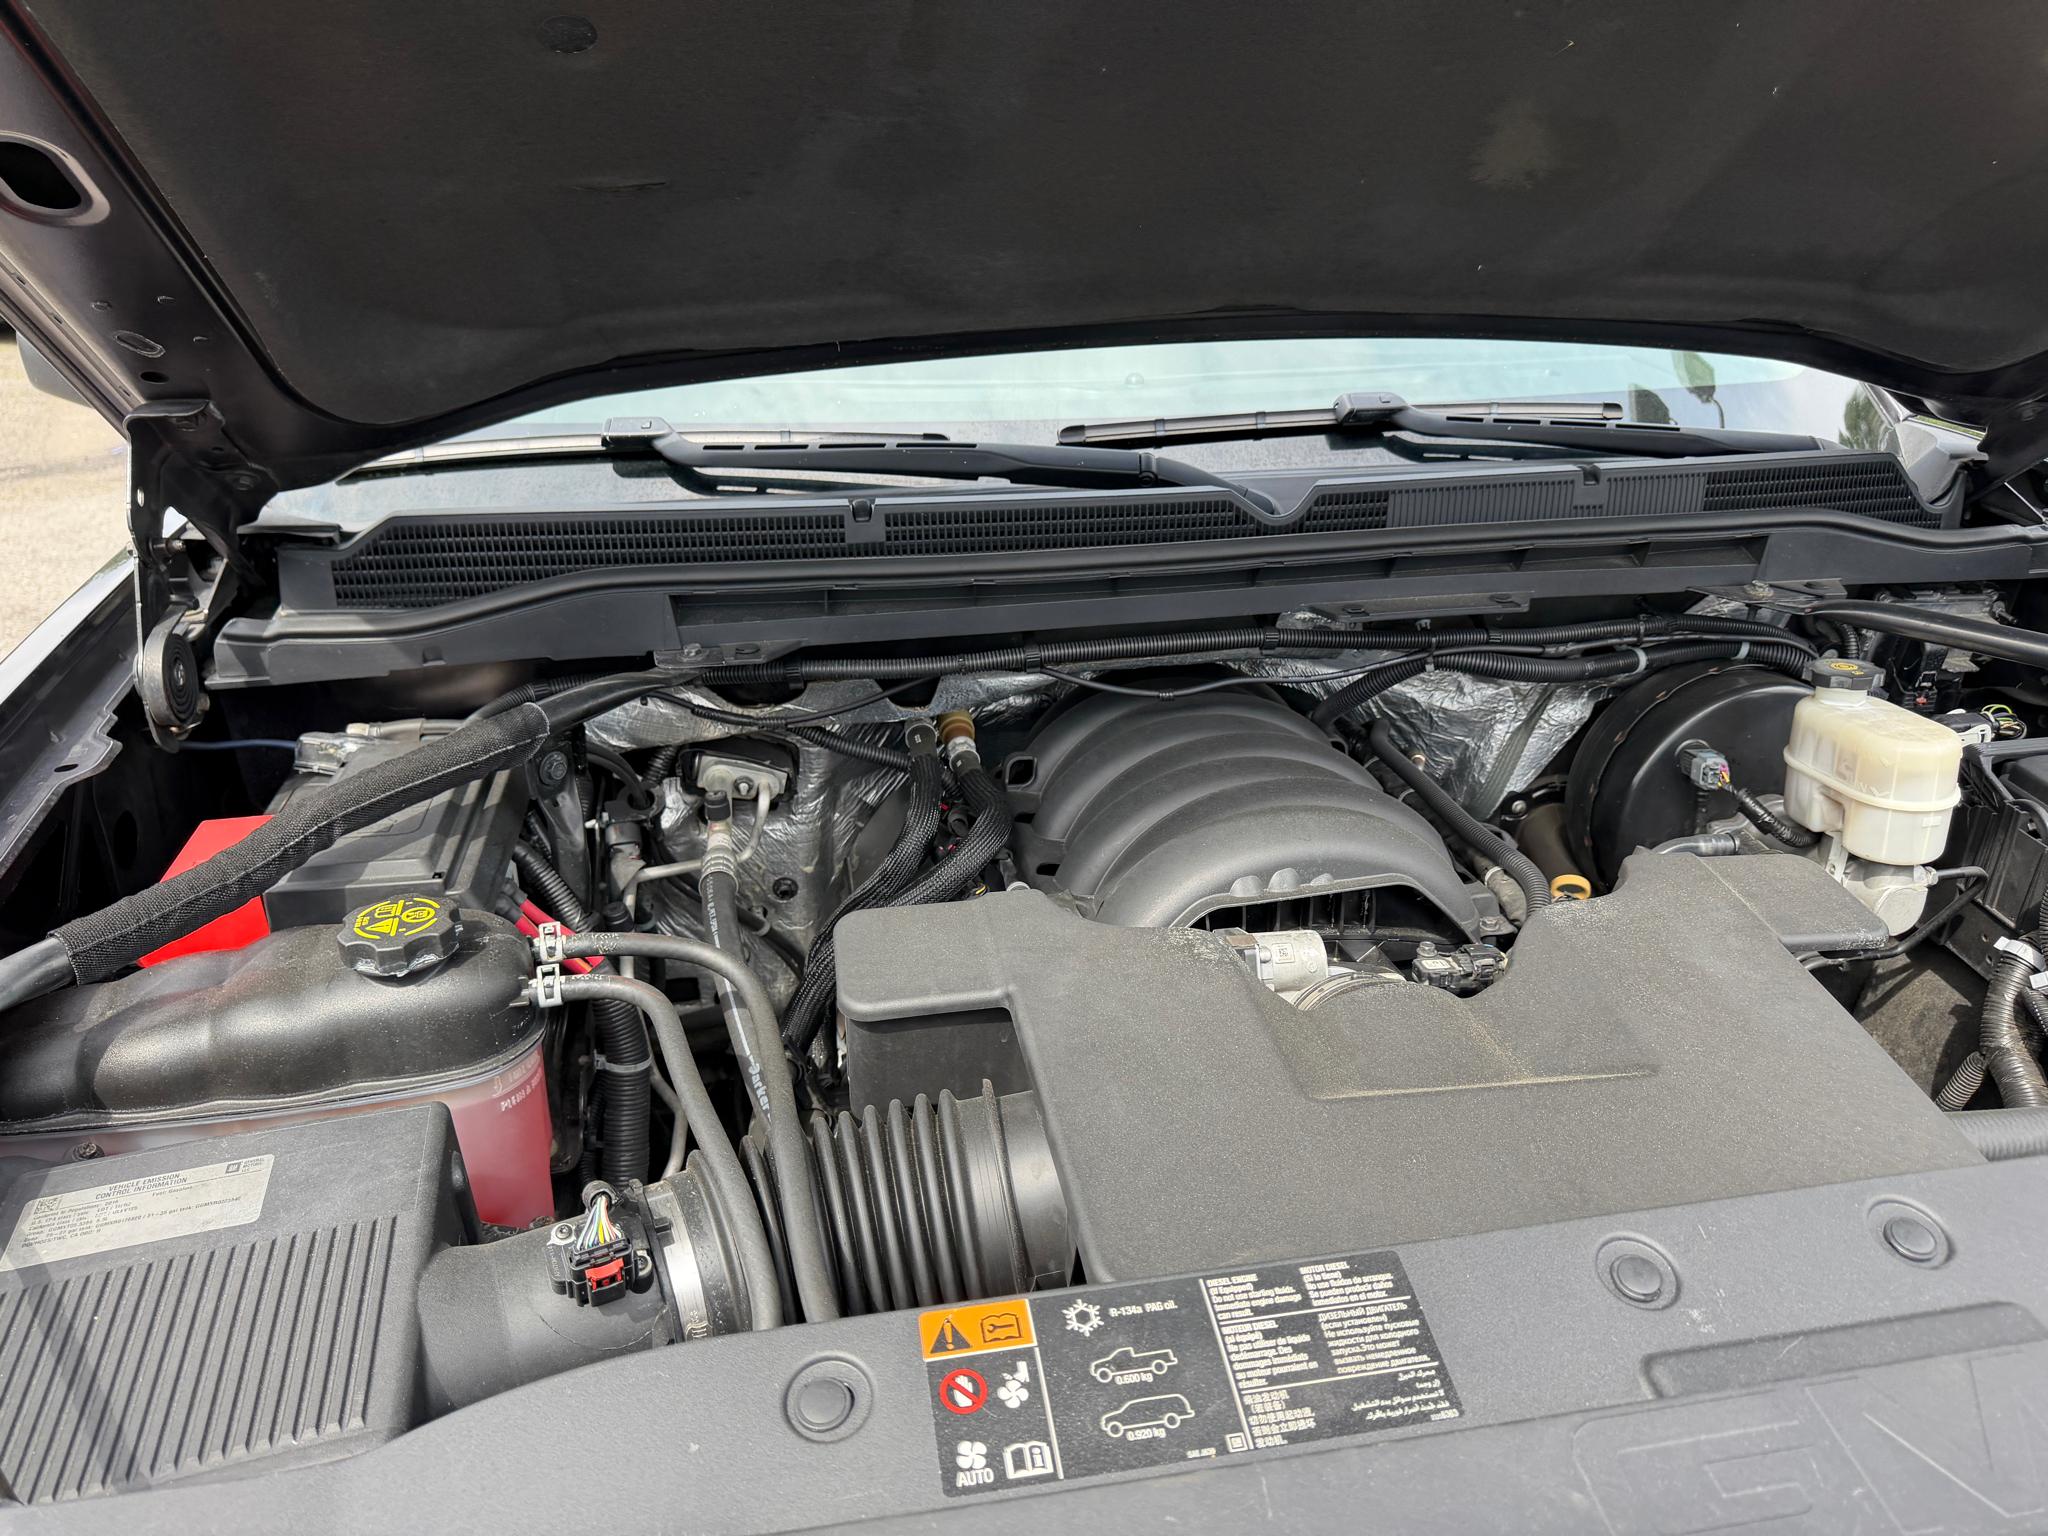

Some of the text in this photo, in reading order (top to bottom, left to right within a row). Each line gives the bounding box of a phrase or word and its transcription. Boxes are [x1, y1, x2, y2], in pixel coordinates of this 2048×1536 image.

[749, 1063, 769, 1110] Parker
[95, 1177, 187, 1200] CONTROL INFORMATION
[109, 1173, 180, 1191] VEHICLE EMISSION
[1299, 1261, 1350, 1275] MOTOR DIESEL
[1206, 1273, 1258, 1287] DIESEL ENGINE
[1329, 1278, 1353, 1287] fluidos
[1352, 1276, 1362, 1284] de
[1211, 1295, 1223, 1303] Do
[1222, 1294, 1236, 1302] not
[1235, 1292, 1248, 1300] use
[1248, 1289, 1275, 1298] starting
[1308, 1290, 1320, 1298] Se
[1319, 1288, 1345, 1298] pueden
[1251, 1296, 1275, 1307] engine
[1273, 1294, 1302, 1303] damage
[1109, 1305, 1143, 1317] R-134a
[1144, 1301, 1164, 1312] PAG
[1217, 1312, 1232, 1320] can
[1318, 1302, 1408, 1322] ДИЗЕЛЬНЫЙ ДВИГАТЕЛЬ
[1221, 1320, 1279, 1335] MOTEUR DIESEL
[1324, 1330, 1336, 1338] Не
[1365, 1334, 1380, 1343] для
[1379, 1328, 1420, 1339] холодного
[1238, 1343, 1253, 1352] pas
[1276, 1337, 1287, 1345] de
[1232, 1356, 1273, 1370] dommages
[1245, 1367, 1272, 1378] moteur
[1308, 1361, 1319, 1369] en
[1115, 1373, 1153, 1385] 0.600 kg
[1126, 1428, 1166, 1441] 0.920 kg
[956, 1468, 994, 1487] AUTO
